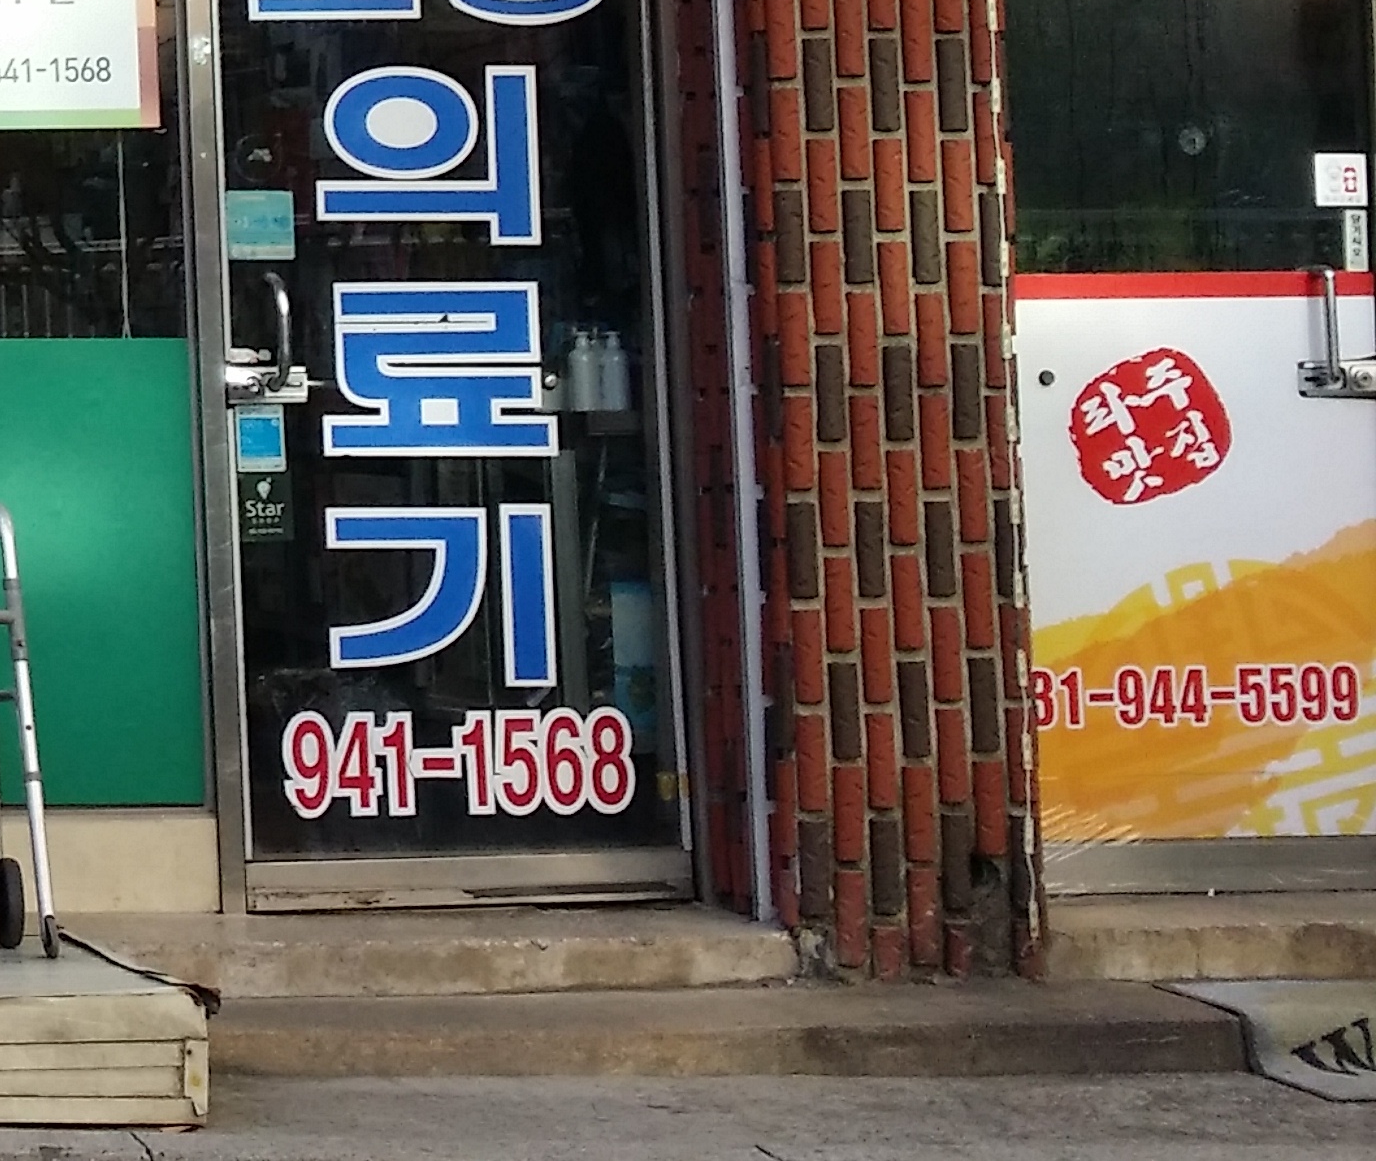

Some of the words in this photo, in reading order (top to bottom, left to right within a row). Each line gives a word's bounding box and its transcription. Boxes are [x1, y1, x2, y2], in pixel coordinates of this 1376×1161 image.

[315, 64, 560, 688] 의료기
[245, 499, 286, 518] Star
[282, 705, 636, 820] 941-1568
